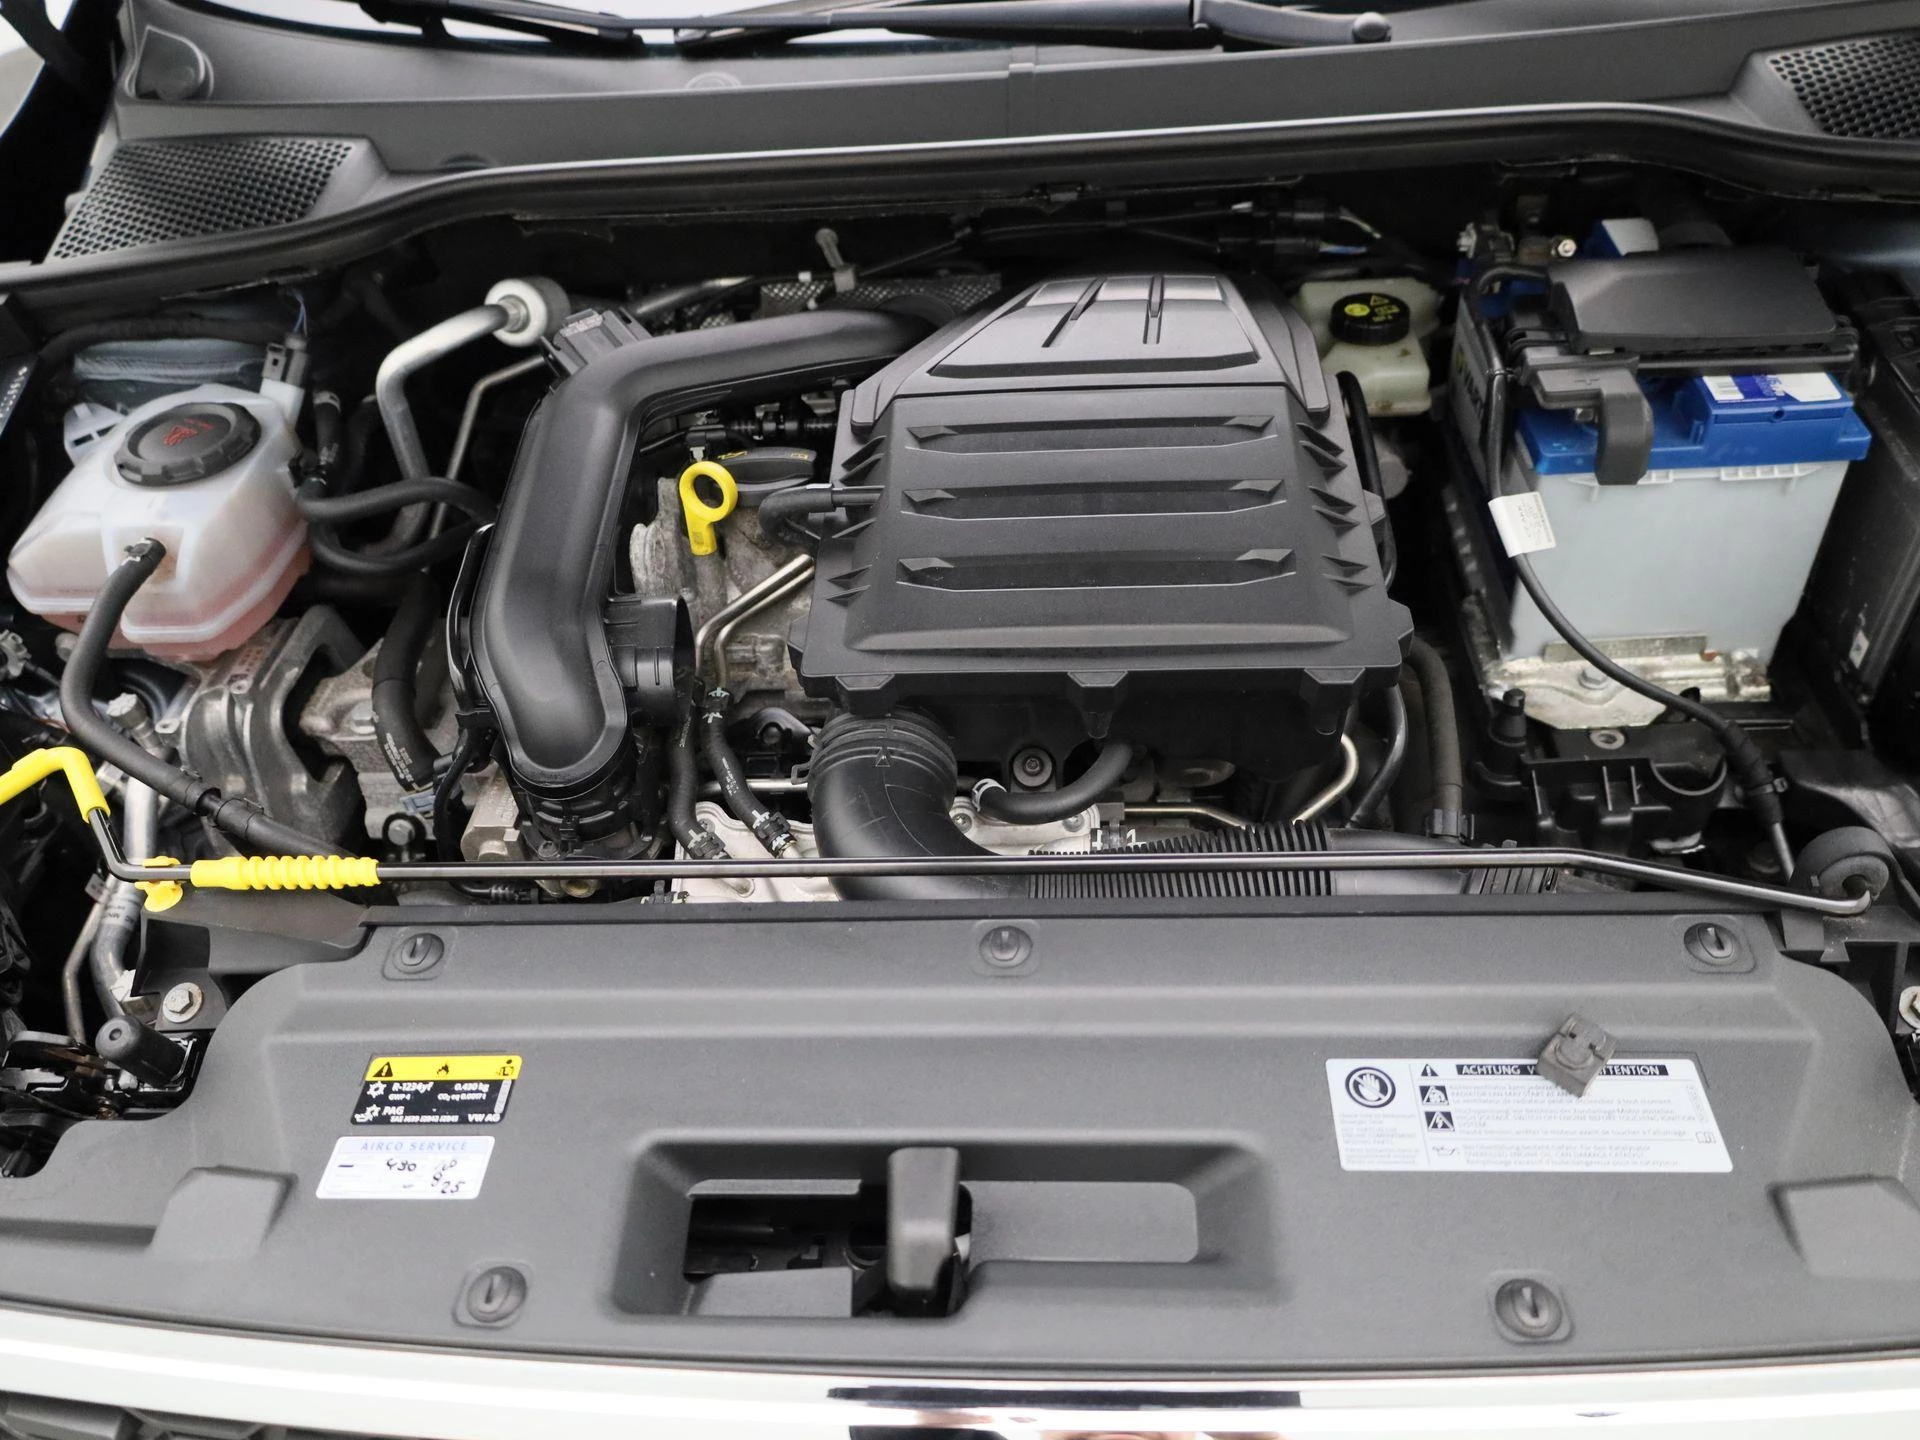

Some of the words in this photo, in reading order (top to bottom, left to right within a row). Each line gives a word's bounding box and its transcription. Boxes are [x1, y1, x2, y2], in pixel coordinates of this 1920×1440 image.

[1462, 1065, 1520, 1075] ACHTUNG
[478, 1082, 490, 1093] kg
[382, 1106, 405, 1116] PAG
[468, 1114, 486, 1122] VW
[485, 1114, 501, 1123] AG
[361, 1142, 404, 1151] AIRCO
[409, 1141, 468, 1150] SERVICE
